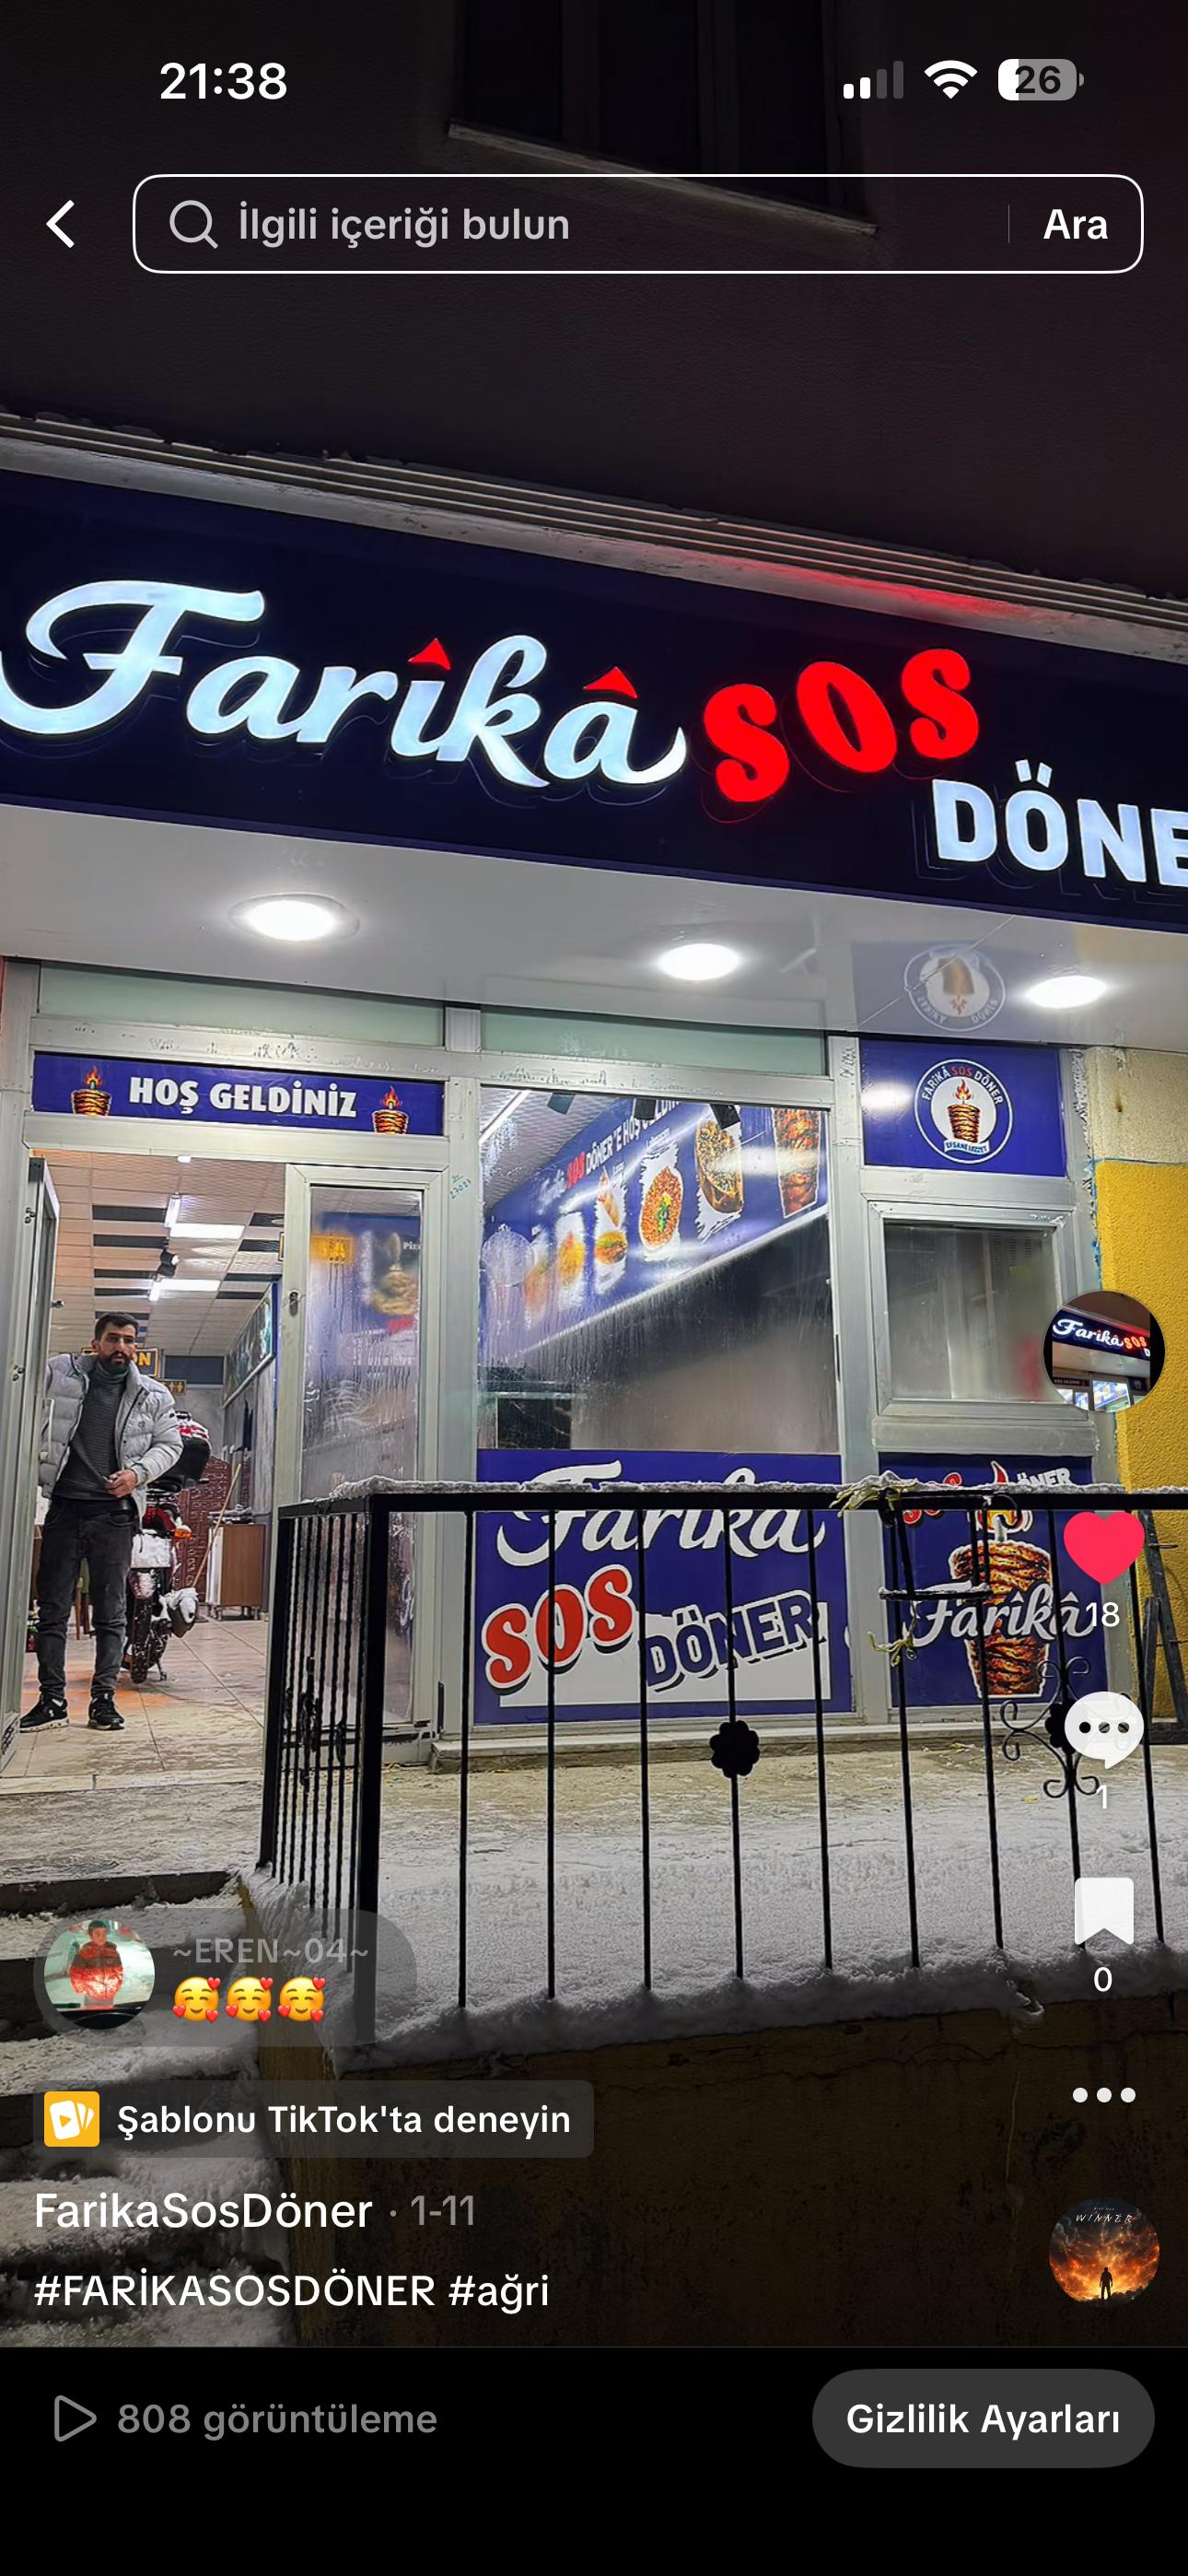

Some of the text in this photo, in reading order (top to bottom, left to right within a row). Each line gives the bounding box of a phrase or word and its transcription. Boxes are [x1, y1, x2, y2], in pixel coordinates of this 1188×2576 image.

[704, 648, 979, 802] SOS
[129, 1076, 358, 1118] HOŞ GELDİNİZ
[949, 1065, 973, 1078] SOS
[973, 1071, 1004, 1105] DÖNER
[482, 1564, 816, 1695] SOS DÖNER
